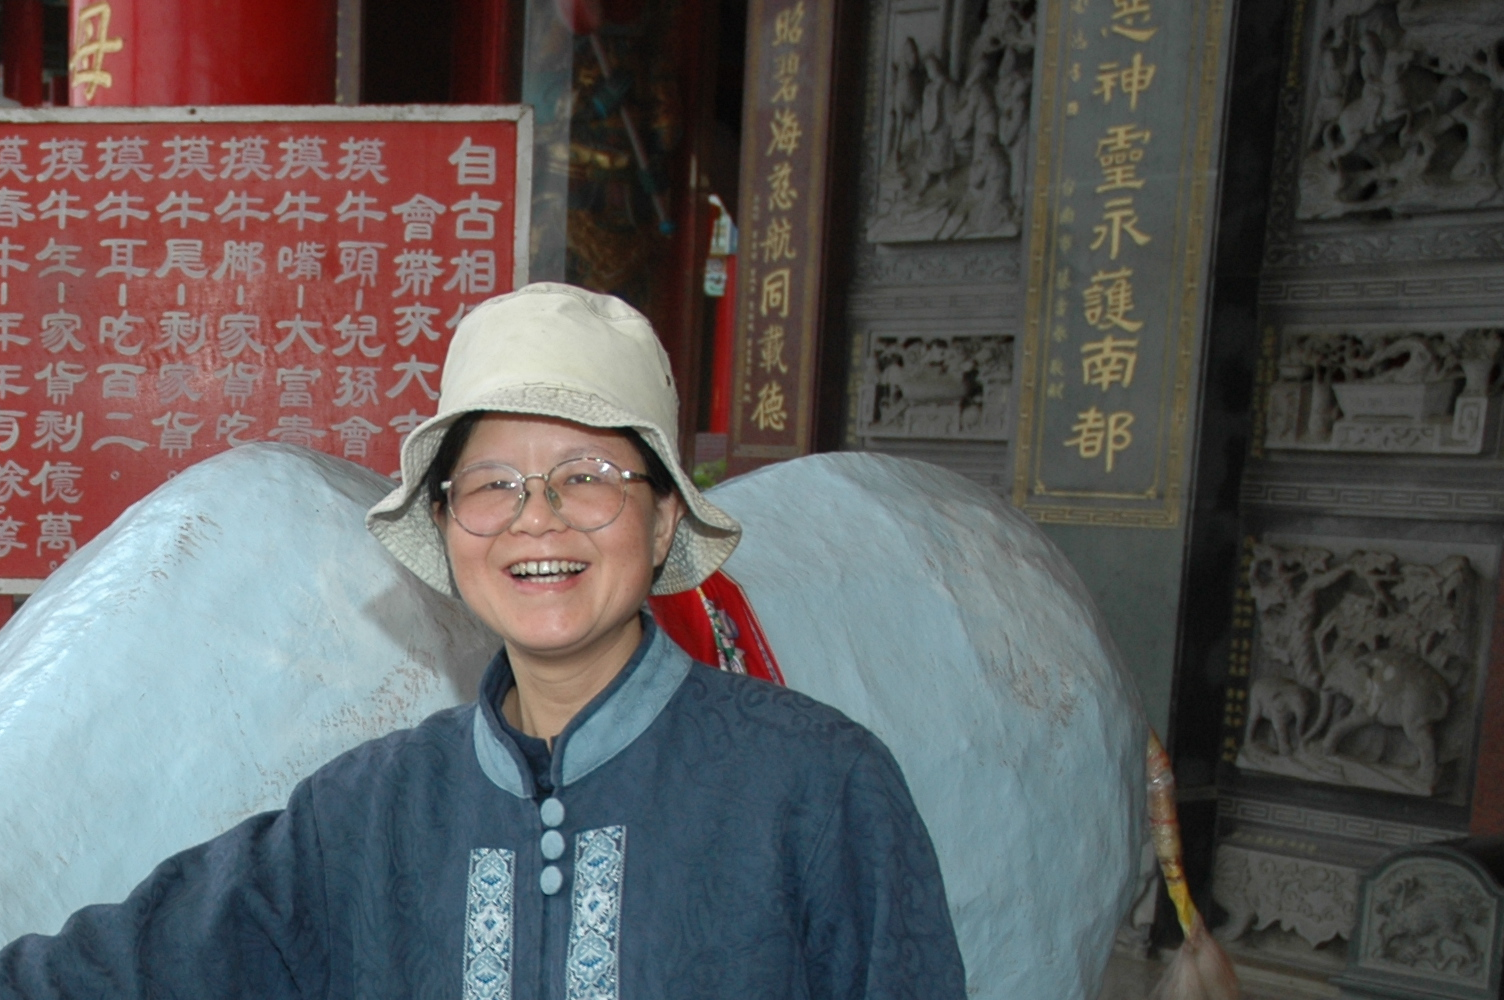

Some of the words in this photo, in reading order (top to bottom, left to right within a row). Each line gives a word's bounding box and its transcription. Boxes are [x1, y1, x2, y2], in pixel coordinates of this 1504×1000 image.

[385, 193, 447, 478] 會帶來大
[443, 136, 502, 334] 自古相
